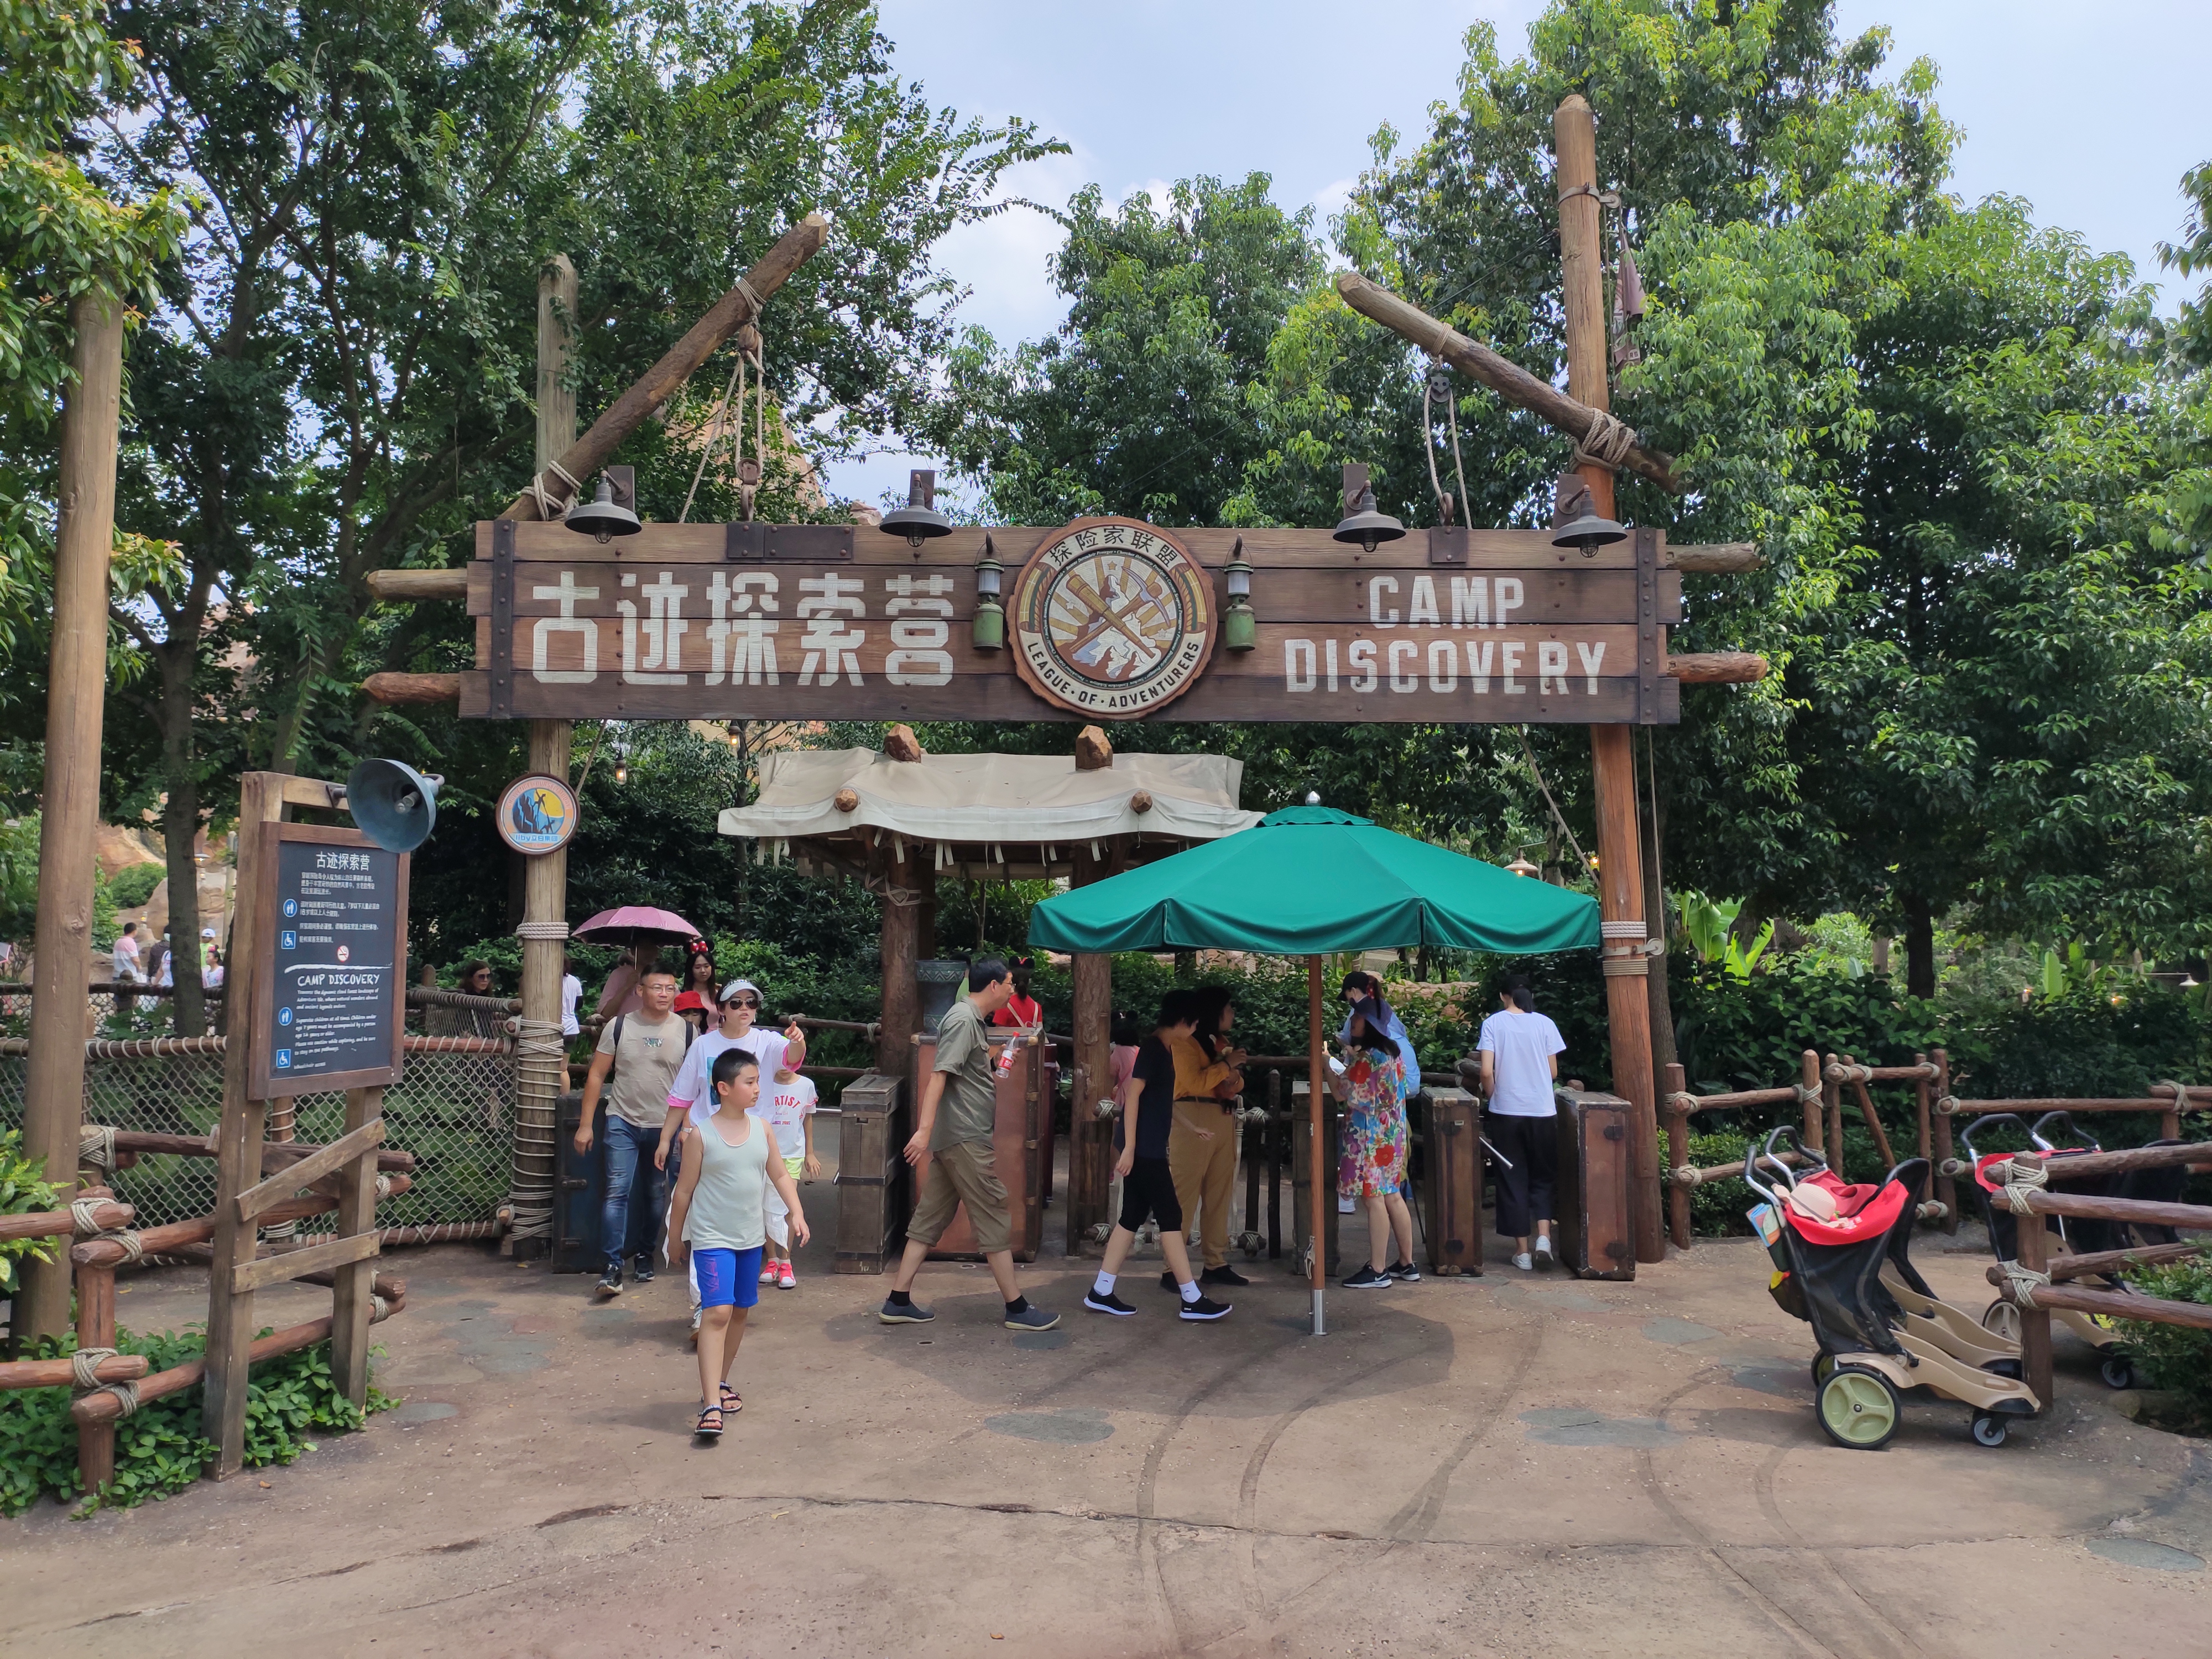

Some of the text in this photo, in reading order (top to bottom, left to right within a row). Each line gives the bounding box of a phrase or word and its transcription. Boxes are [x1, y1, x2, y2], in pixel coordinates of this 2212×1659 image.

[1050, 526, 1177, 567] 探险家联盟
[1369, 576, 1524, 629] CAMP
[533, 571, 954, 686] 古迹探索营
[1027, 641, 1199, 708] LEAGUE OF ADVENTURERS
[1285, 639, 1606, 695] DISCOVERY
[316, 851, 371, 872] 古迹探索营
[298, 974, 379, 986] CAMP DISCOVERY
[775, 1095, 801, 1108] RTIST
